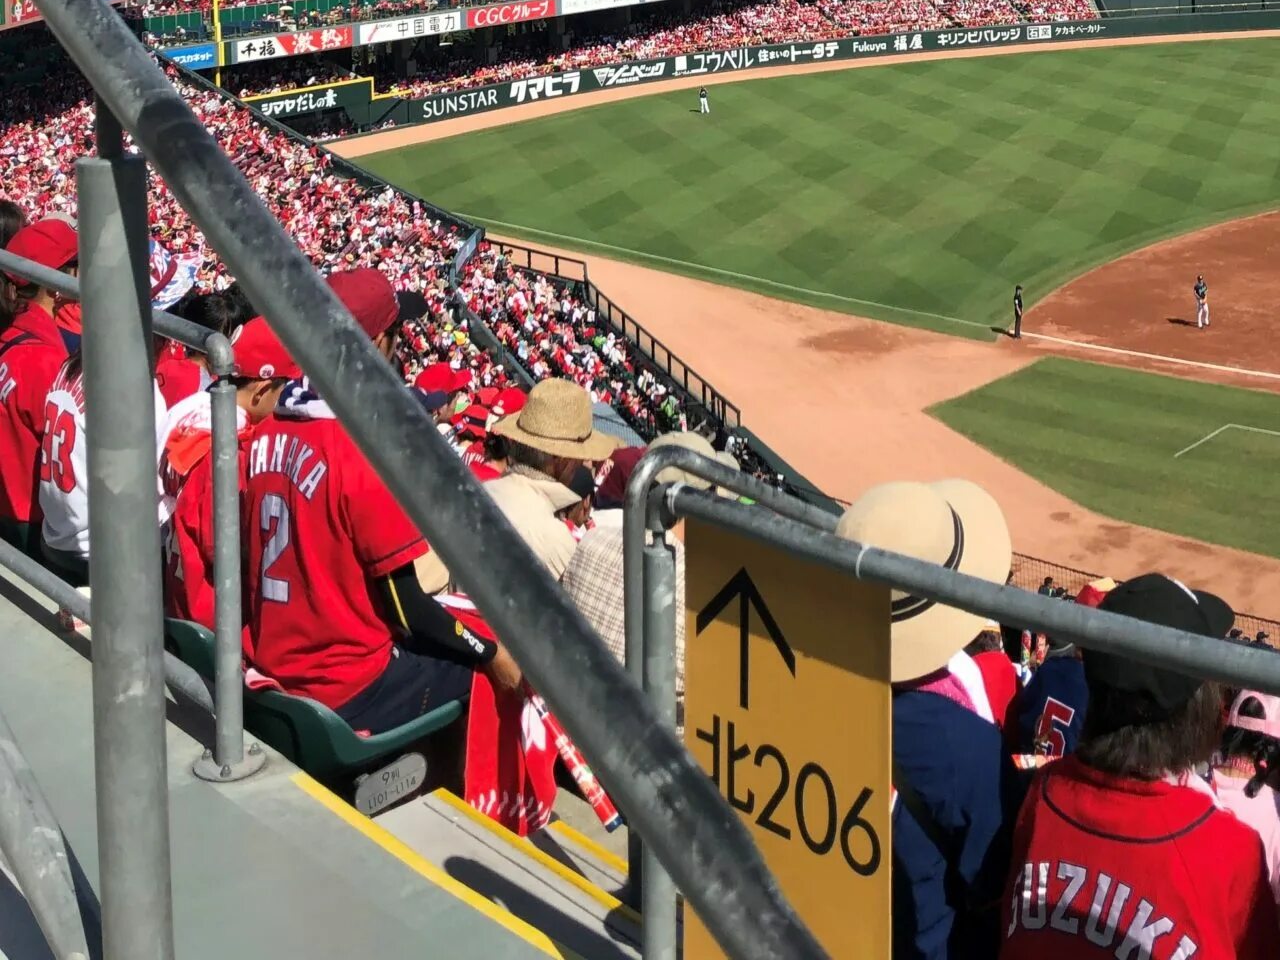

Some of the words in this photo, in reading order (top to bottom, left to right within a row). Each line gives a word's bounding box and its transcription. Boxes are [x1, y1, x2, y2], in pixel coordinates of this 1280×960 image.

[397, 16, 455, 36] 中国電力
[473, 0, 549, 26] CGCグループ
[853, 41, 887, 52] Fukuya
[894, 34, 923, 51] 福屋
[937, 28, 1021, 46] キリンビバレッジ
[1055, 25, 1106, 36] タカキベーカリー
[241, 40, 277, 57] 千福
[691, 48, 754, 74] ユウベル
[509, 71, 581, 102] クマヒラ
[261, 89, 337, 116] シマヤだしの素
[423, 89, 498, 118] SUNSTAR
[249, 433, 328, 502] TANAKA
[260, 493, 290, 603] 2
[1037, 696, 1075, 758] 5
[696, 714, 882, 877] 北206
